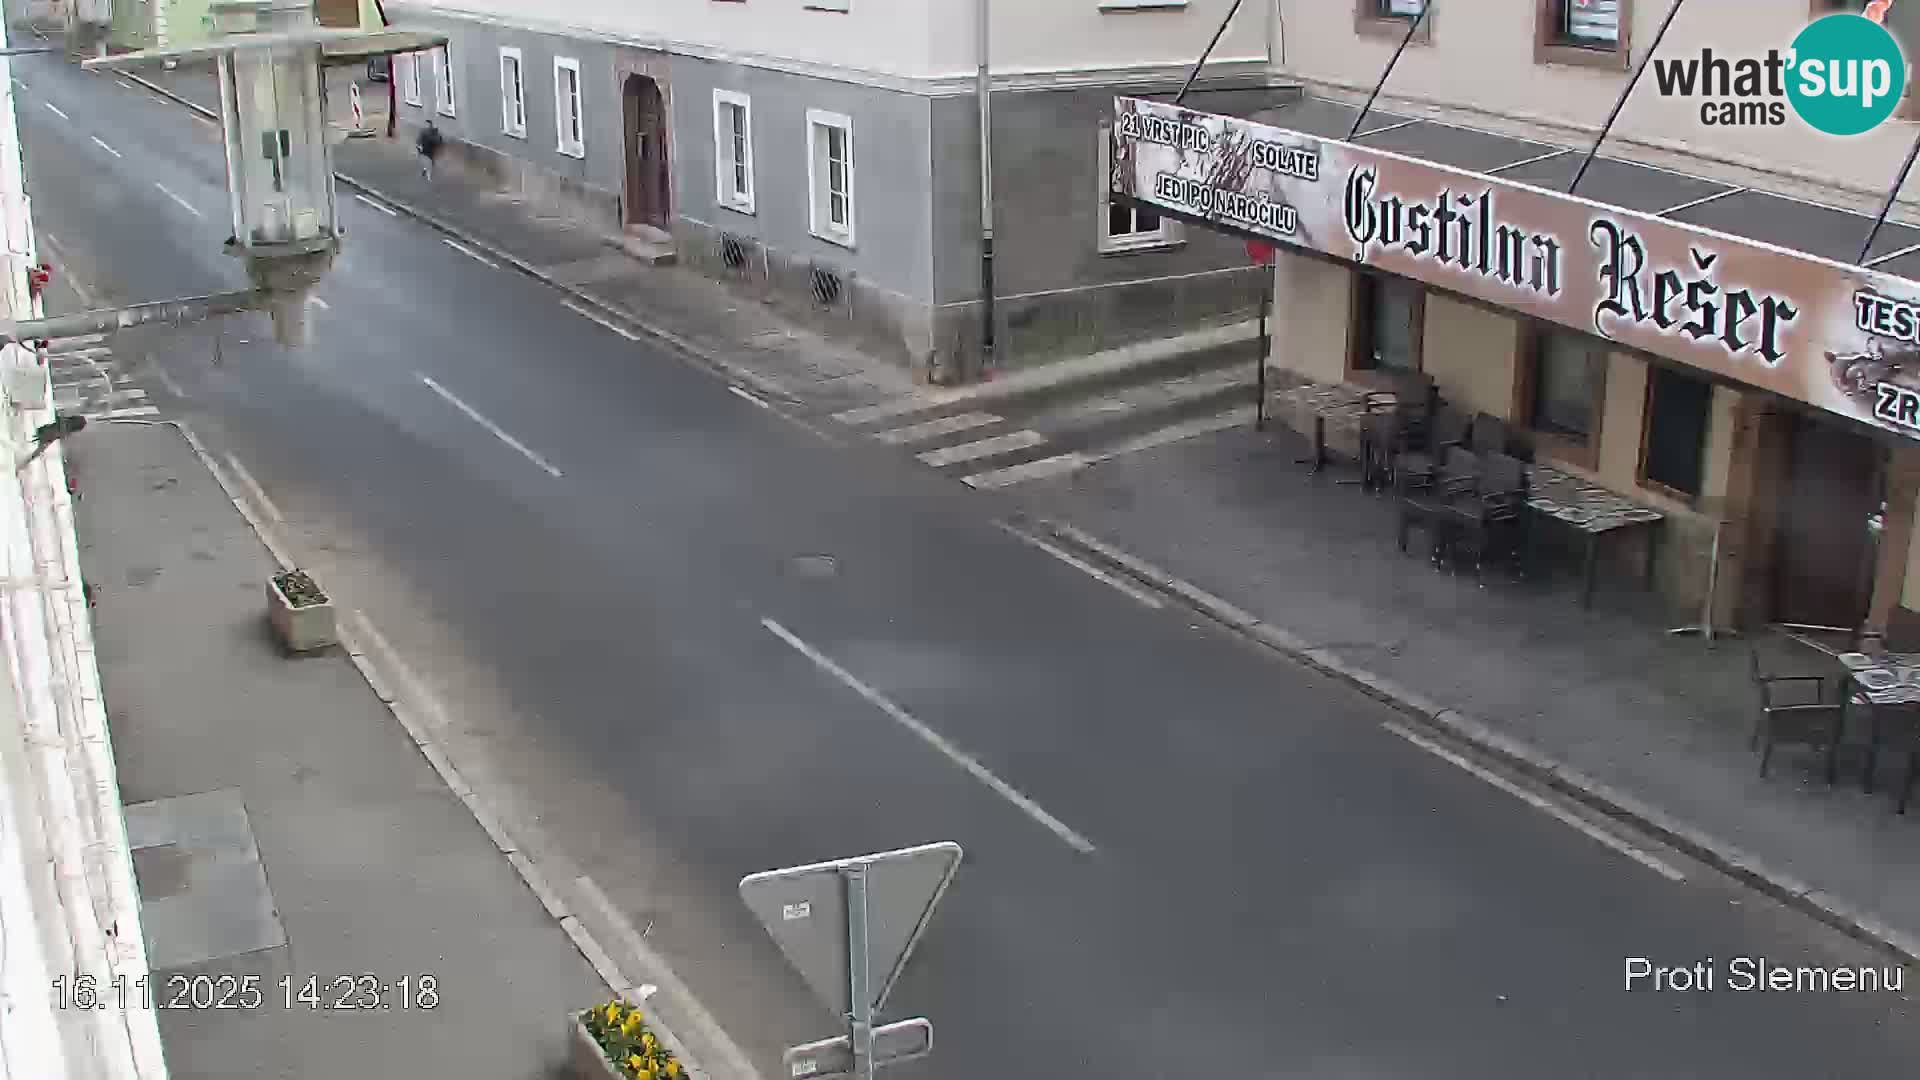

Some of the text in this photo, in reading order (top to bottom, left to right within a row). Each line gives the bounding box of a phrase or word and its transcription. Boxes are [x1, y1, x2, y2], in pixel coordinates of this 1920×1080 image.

[1124, 114, 1208, 151] 21 VRST PIC
[1255, 142, 1317, 178] SOLATE
[1157, 174, 1296, 232] JEDI PO NAROČILU
[1344, 163, 1798, 364] Gostilna Rešer
